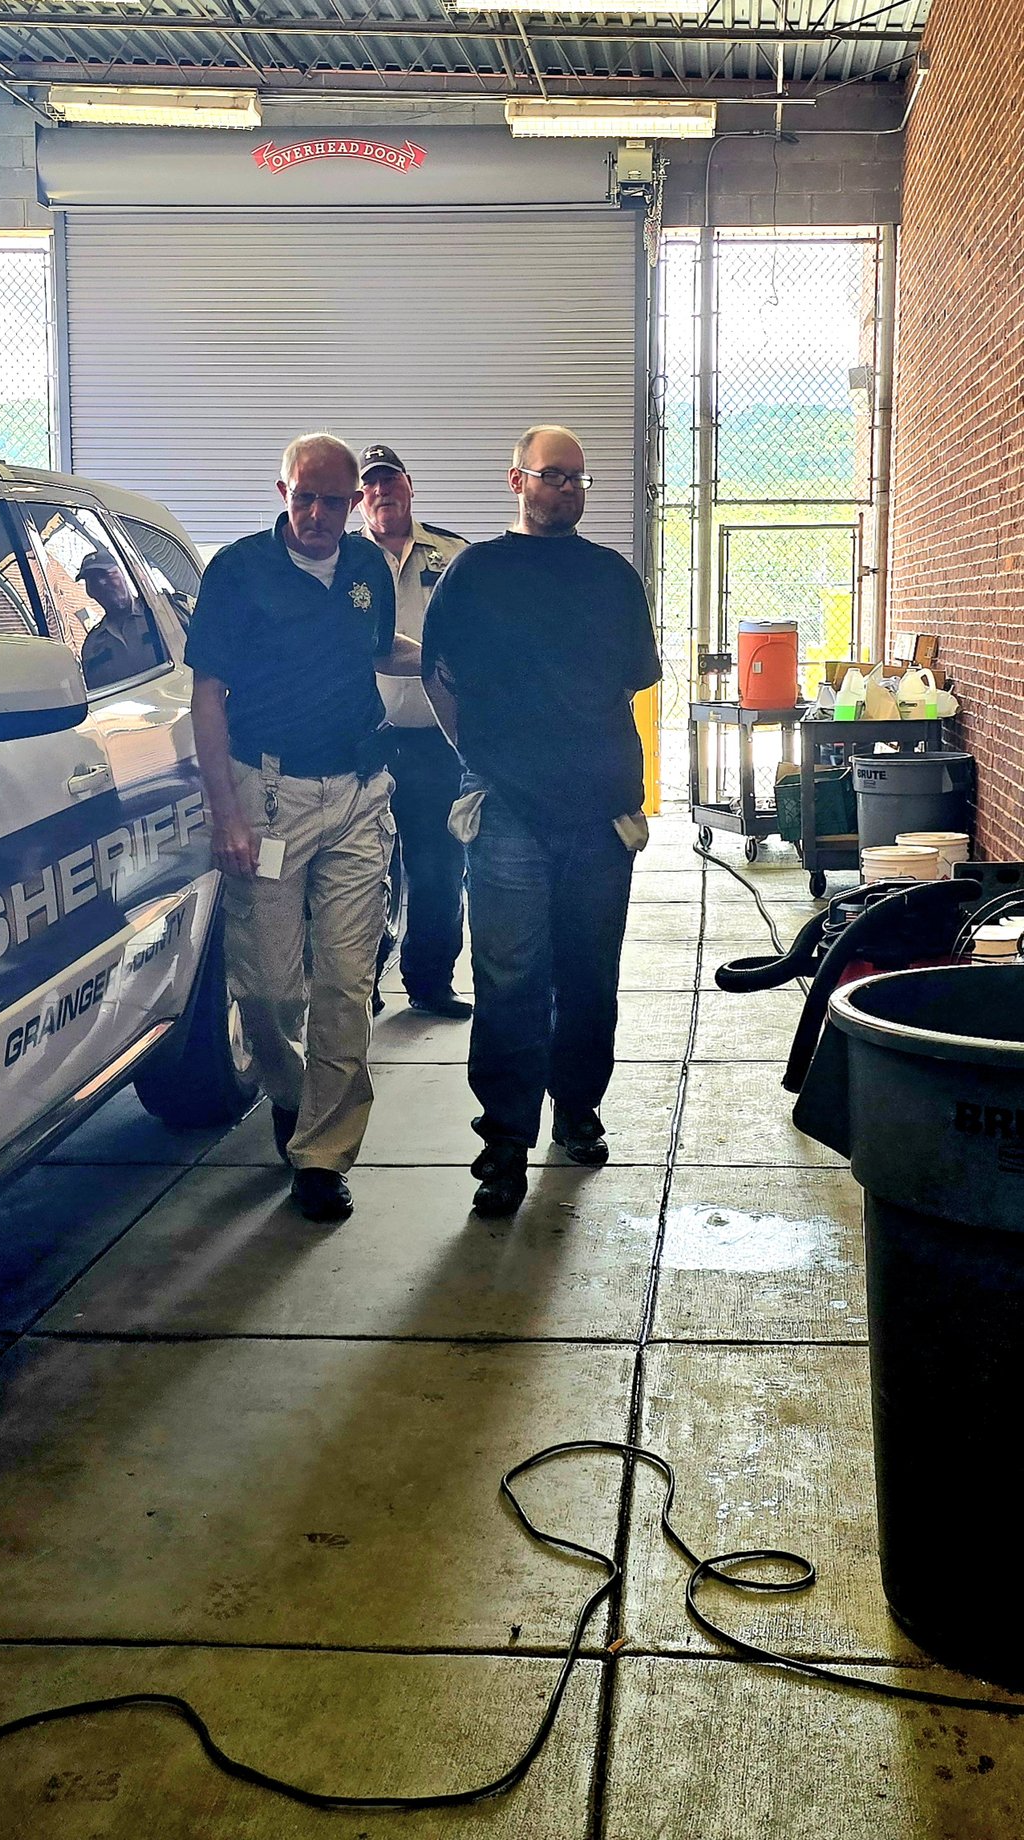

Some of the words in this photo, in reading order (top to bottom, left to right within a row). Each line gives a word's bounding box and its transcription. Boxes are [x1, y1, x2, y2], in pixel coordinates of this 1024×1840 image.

[271, 142, 360, 168] OVERHEAD
[362, 143, 407, 169] DOOR
[857, 768, 888, 780] BRUTE
[125, 907, 186, 976] OUTY
